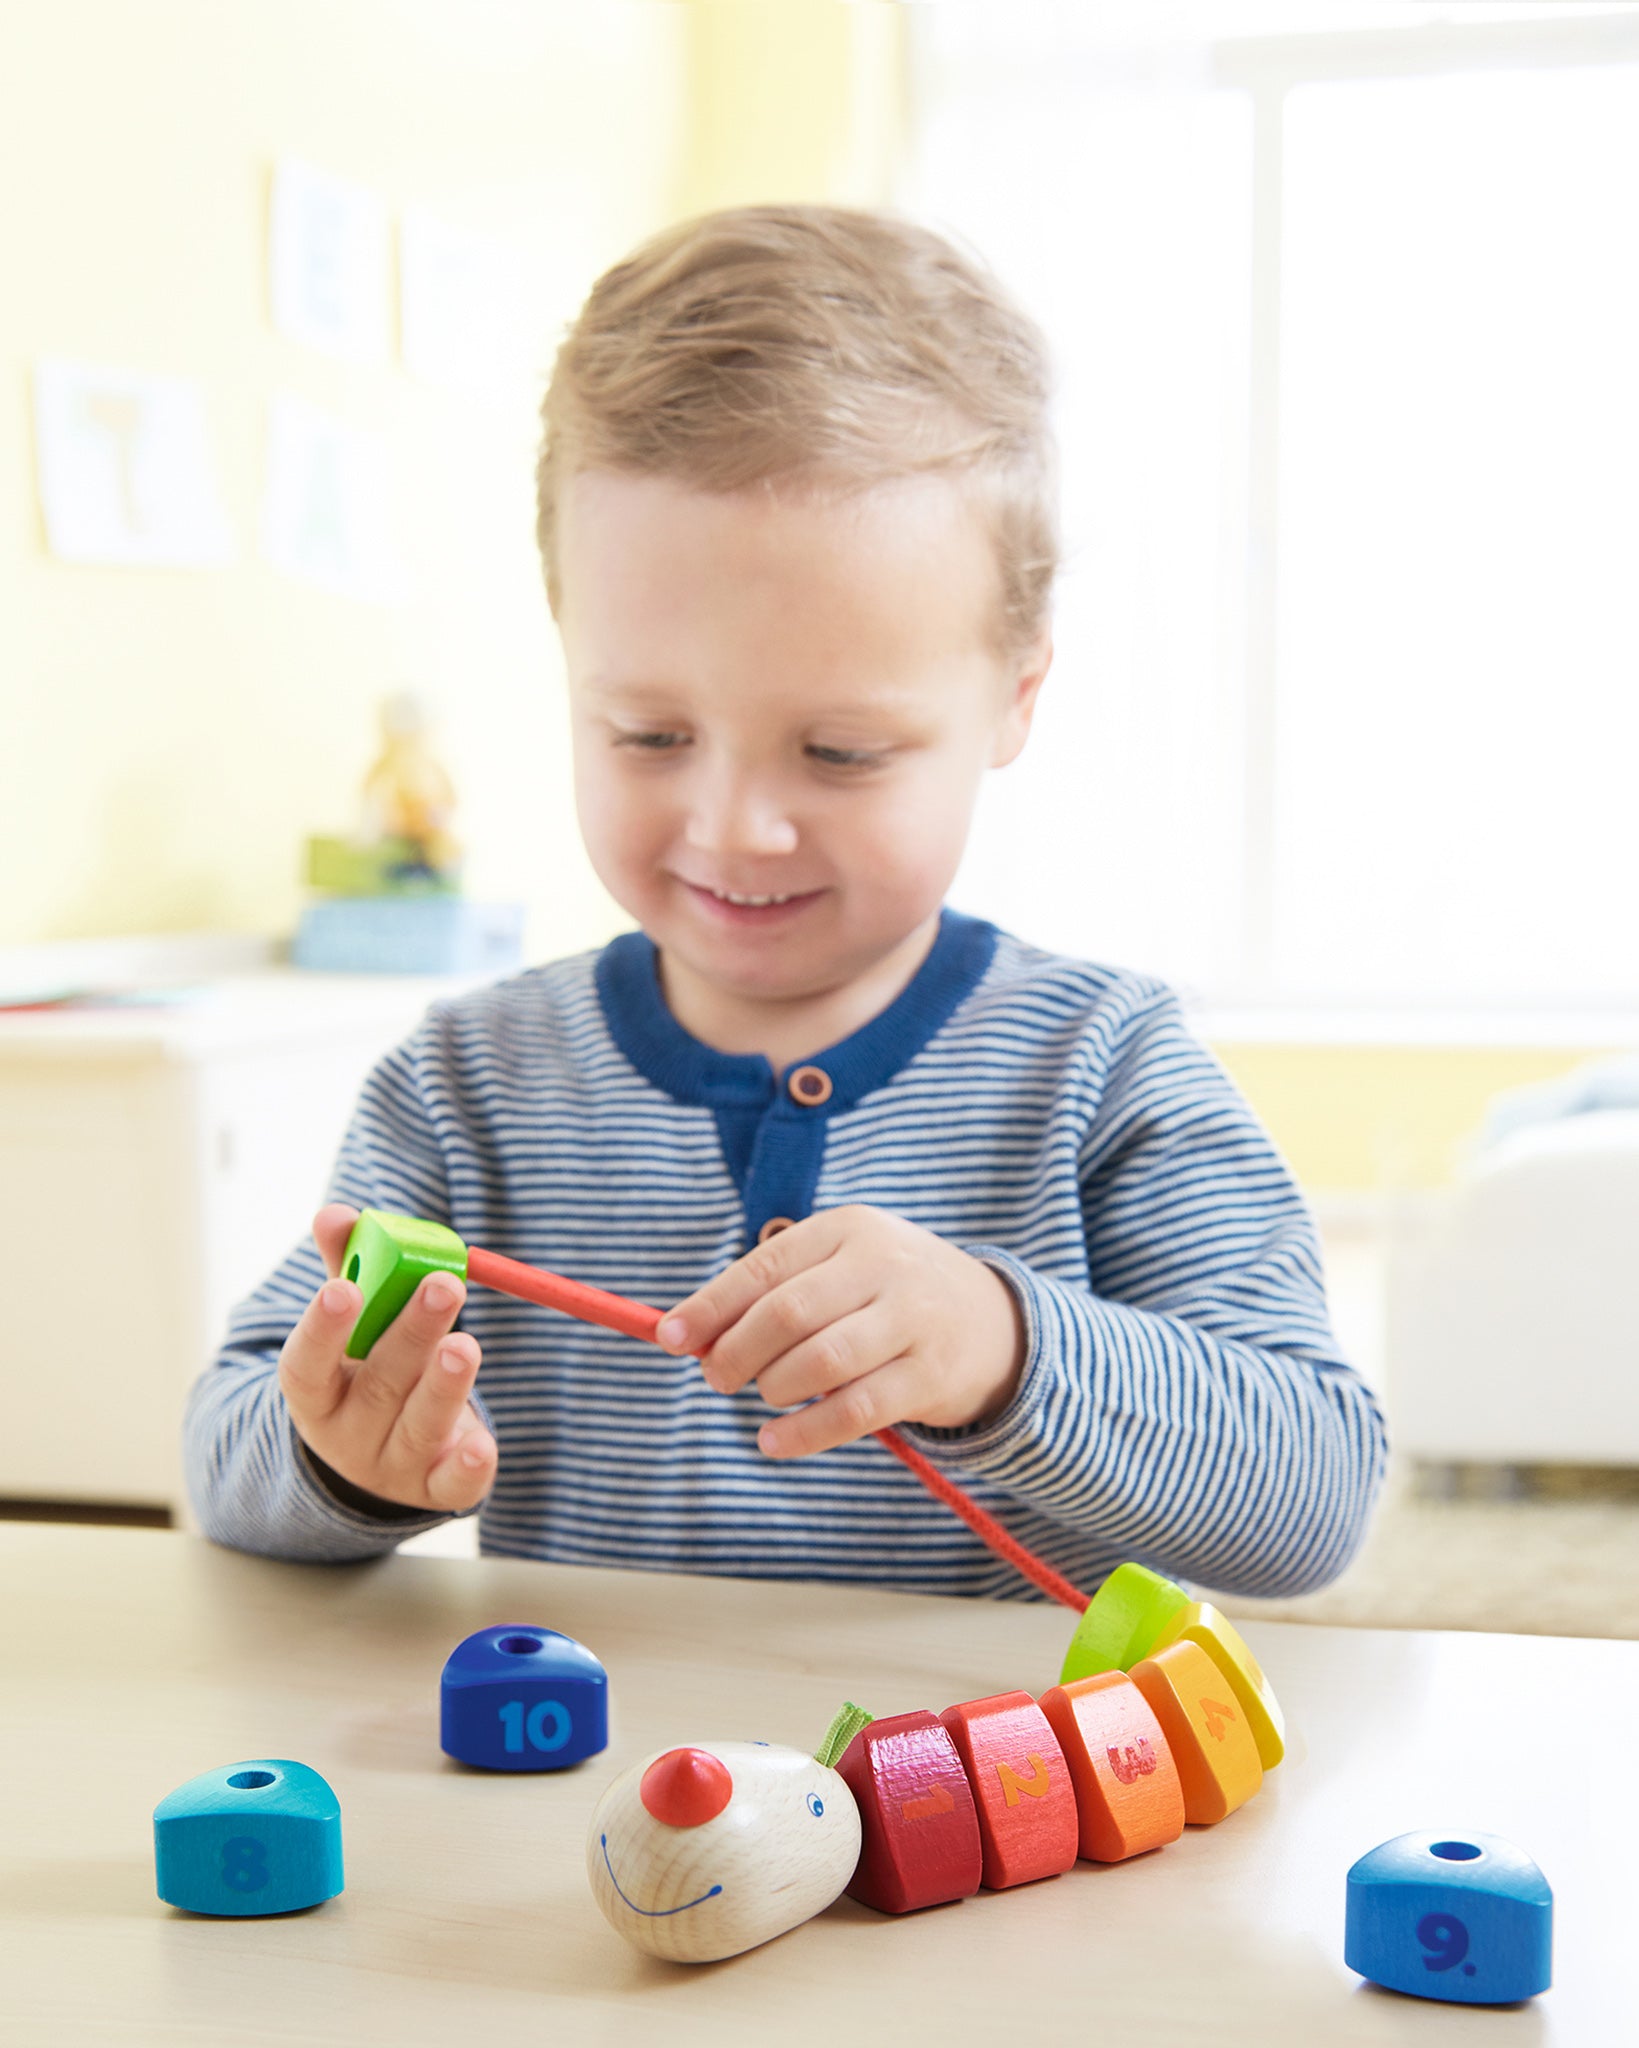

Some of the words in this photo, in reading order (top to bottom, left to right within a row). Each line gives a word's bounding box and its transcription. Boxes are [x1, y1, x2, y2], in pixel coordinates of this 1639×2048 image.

[499, 1701, 572, 1752] 10
[1199, 1698, 1236, 1742] 4
[997, 1754, 1049, 1807] 2
[1107, 1736, 1157, 1784] 3
[903, 1783, 953, 1820] 1
[221, 1837, 269, 1892] 8
